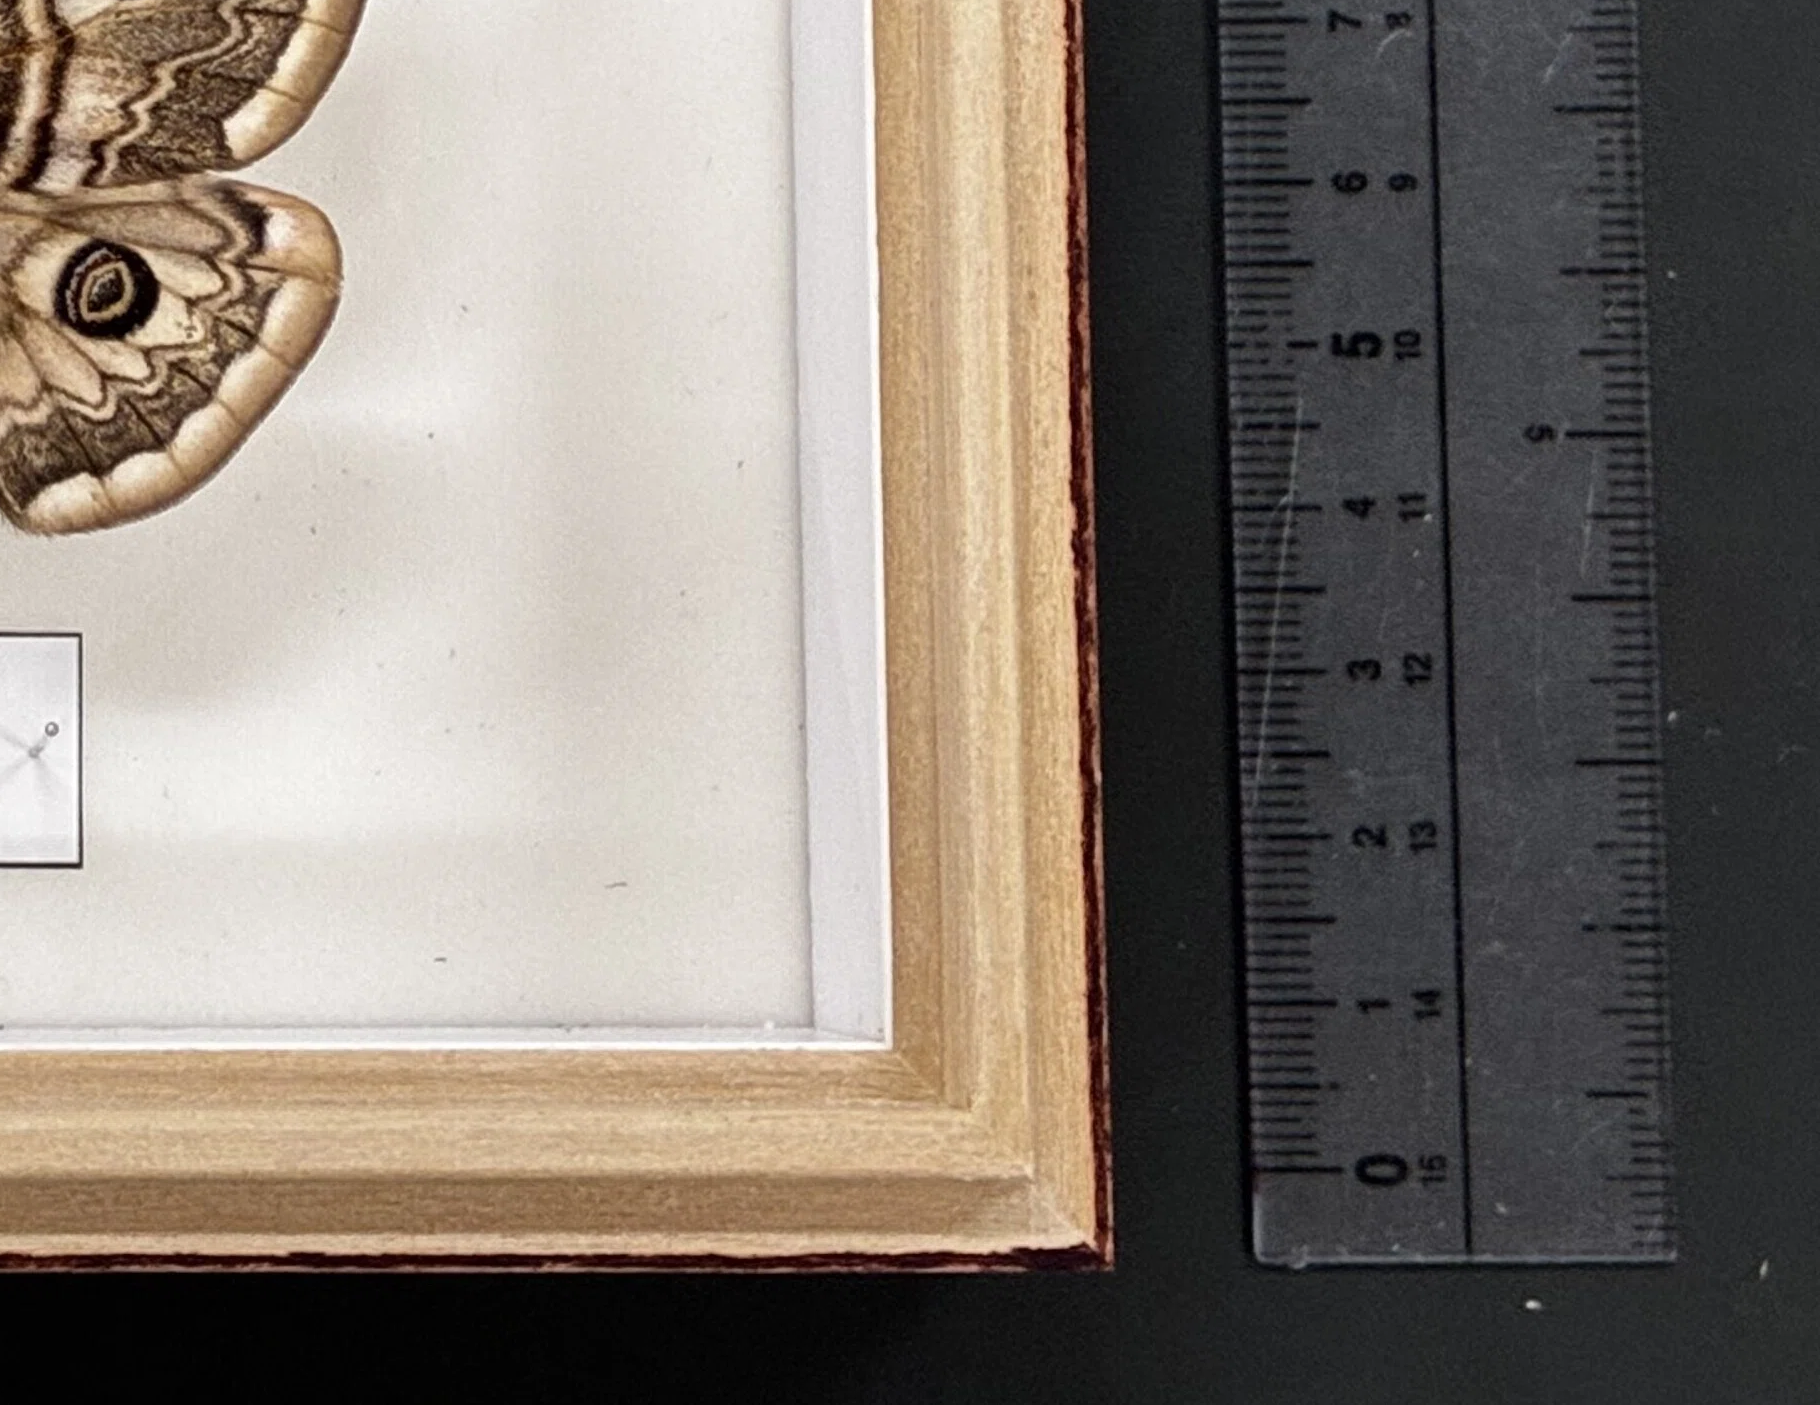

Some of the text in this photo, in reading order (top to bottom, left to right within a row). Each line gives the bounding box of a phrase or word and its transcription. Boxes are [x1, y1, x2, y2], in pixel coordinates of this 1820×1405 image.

[1327, 9, 1362, 32] 7
[1331, 171, 1368, 194] 6
[1388, 173, 1418, 193] 9
[1330, 331, 1383, 360] 5
[1393, 329, 1422, 361] 10
[1523, 424, 1557, 444] 5
[1342, 497, 1376, 519] 4
[1397, 492, 1427, 523] 11
[1346, 659, 1382, 681] 3
[1403, 652, 1433, 686] 12
[1352, 827, 1389, 849] 2
[1407, 821, 1438, 854] 13
[1357, 999, 1391, 1013] 1
[1411, 990, 1442, 1021] 14
[1354, 1154, 1409, 1186] 0
[1418, 1155, 1448, 1186] 15
